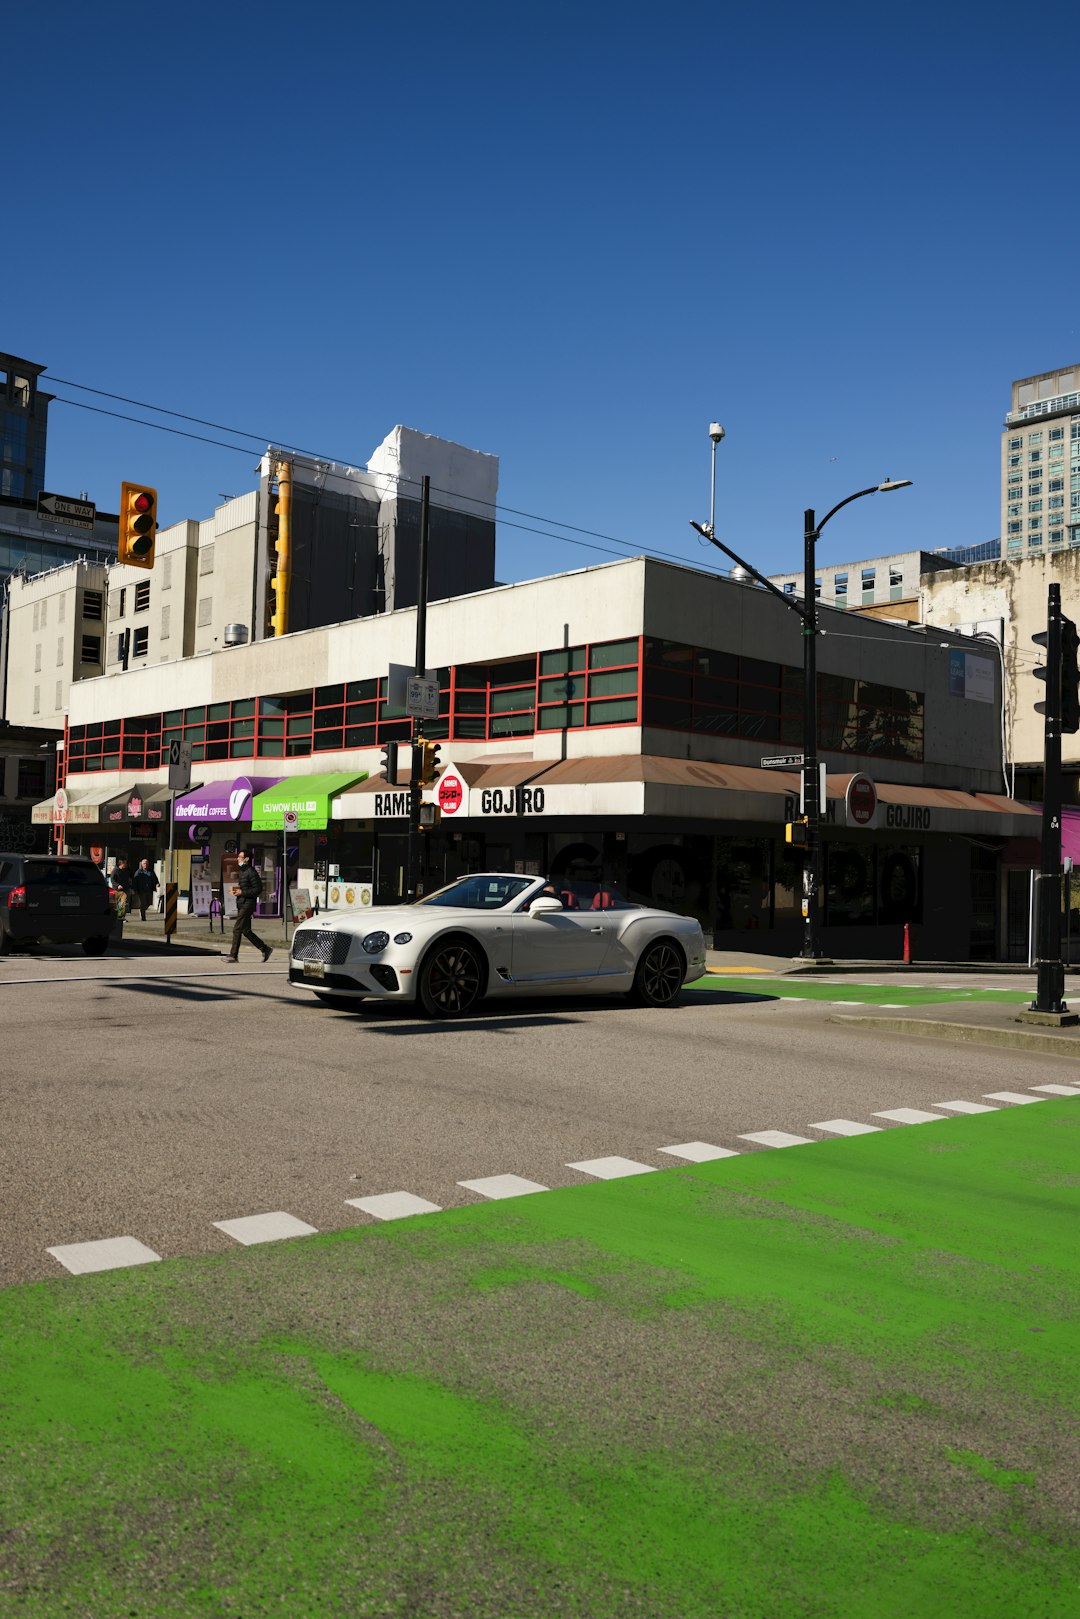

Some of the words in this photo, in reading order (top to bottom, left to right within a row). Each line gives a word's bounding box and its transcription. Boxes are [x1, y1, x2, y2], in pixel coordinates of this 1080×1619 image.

[55, 501, 71, 511] ONE
[75, 505, 91, 516] WAY
[208, 807, 228, 816] COFFEE
[375, 793, 410, 816] RAME
[481, 787, 544, 814] GOJIRO
[886, 804, 931, 829] GOJIRO
